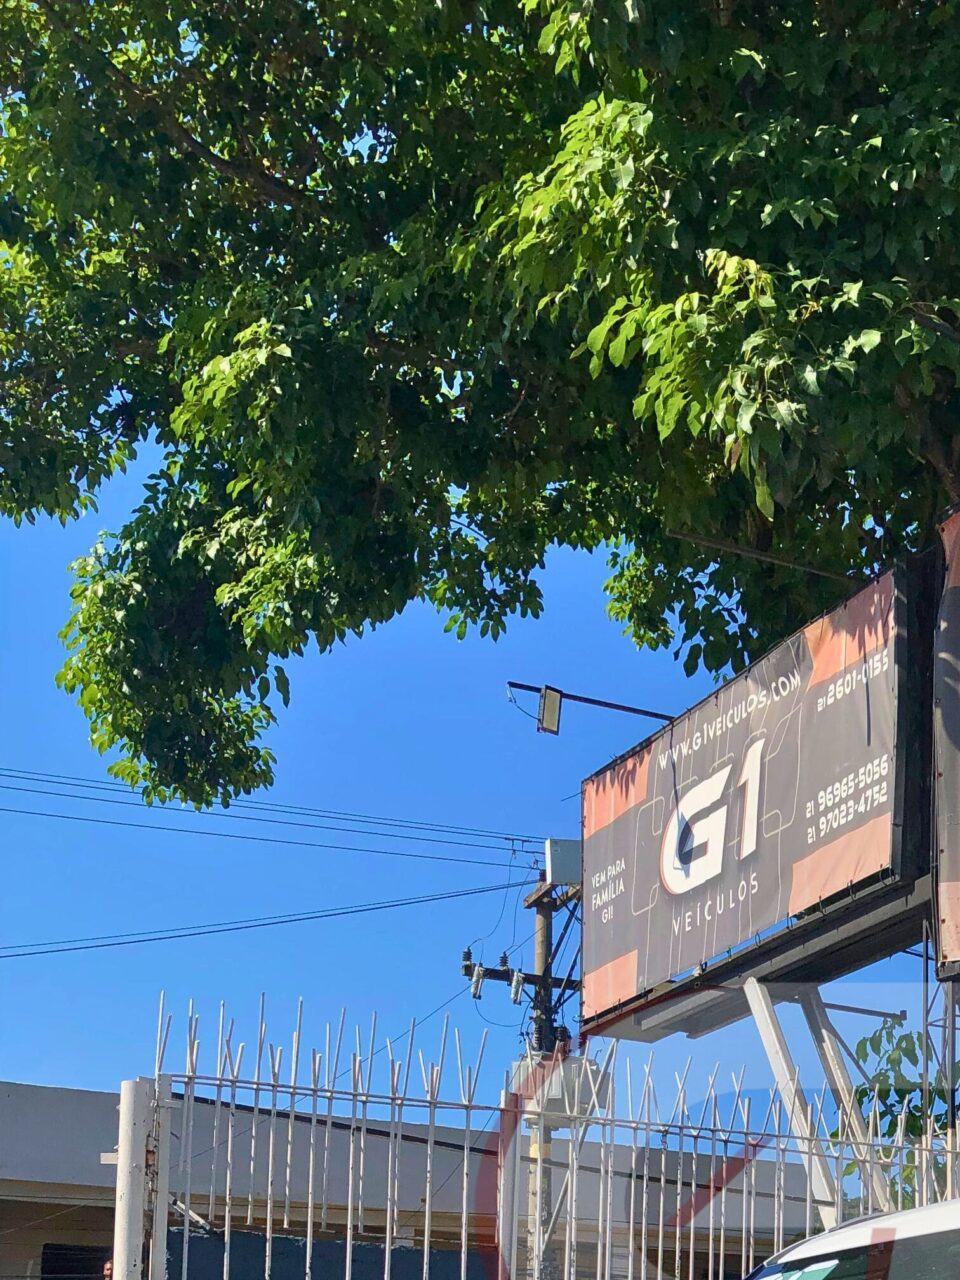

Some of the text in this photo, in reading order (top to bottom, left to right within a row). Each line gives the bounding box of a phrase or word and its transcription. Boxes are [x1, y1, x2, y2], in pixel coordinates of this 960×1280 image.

[827, 649, 889, 706] 2601-0155
[658, 669, 802, 770] WWW.G1VEICULOS.COM
[818, 754, 889, 812] 96965-5056
[819, 781, 888, 839] 97023-4752
[660, 738, 766, 896] G1
[592, 857, 626, 889] VEM PARA
[673, 876, 759, 937] VEÍCULOS
